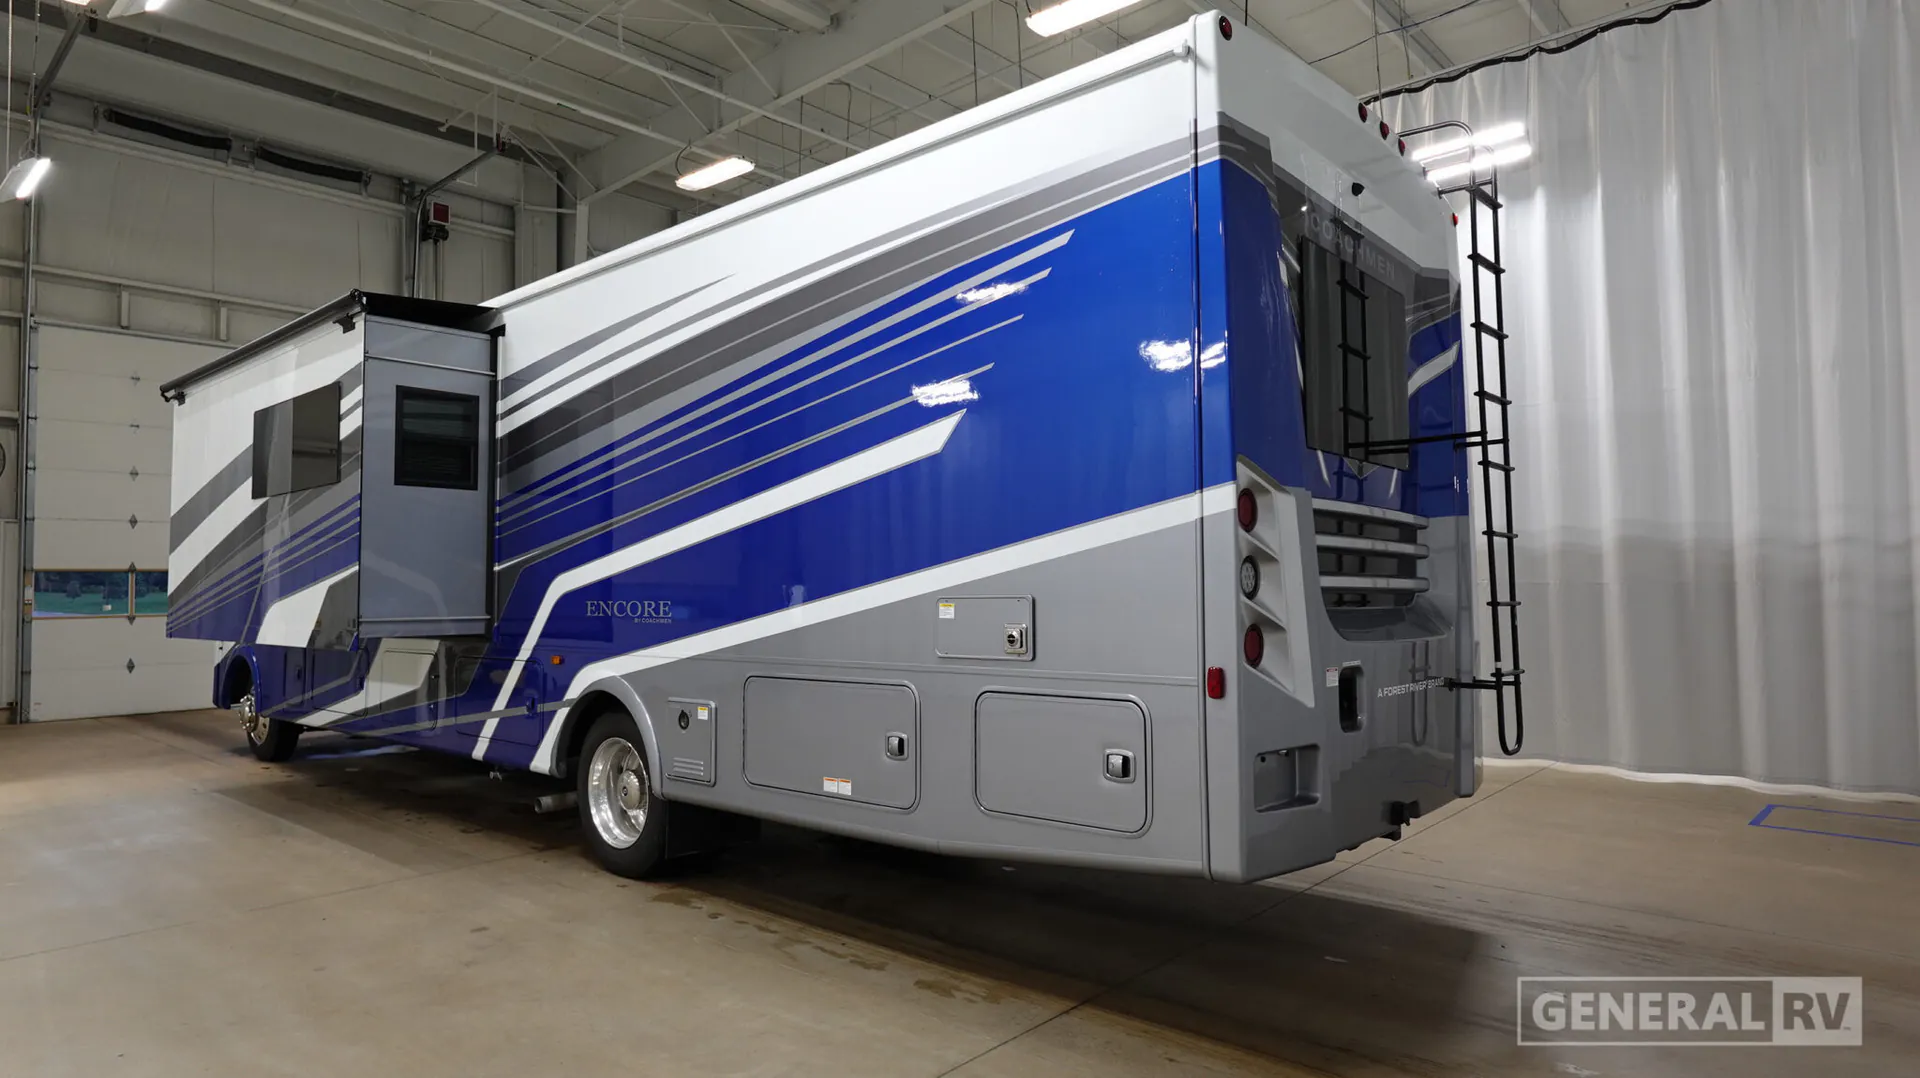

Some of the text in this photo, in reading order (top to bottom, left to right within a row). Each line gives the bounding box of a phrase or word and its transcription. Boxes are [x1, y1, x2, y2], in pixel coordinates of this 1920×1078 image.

[586, 601, 672, 617] ENCORE
[1377, 688, 1383, 698] A
[1383, 684, 1410, 696] FOREST
